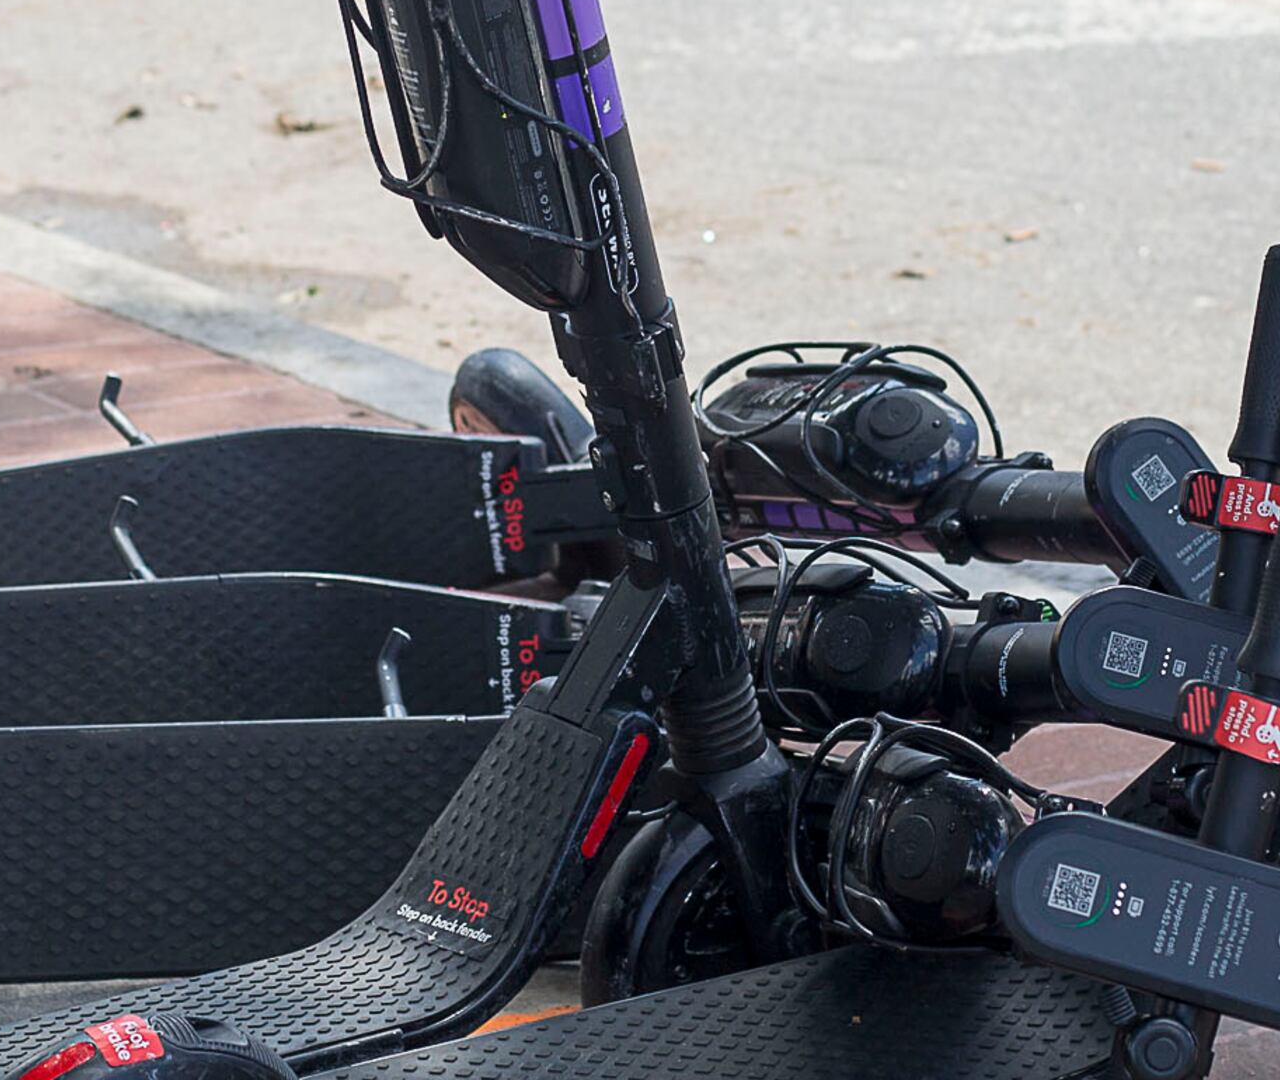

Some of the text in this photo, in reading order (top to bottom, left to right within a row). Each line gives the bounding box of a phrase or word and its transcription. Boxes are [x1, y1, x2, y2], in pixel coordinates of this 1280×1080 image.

[479, 451, 493, 481] Step
[482, 482, 492, 499] on
[1225, 491, 1235, 512] stop
[1232, 483, 1245, 522] press to
[1244, 494, 1255, 514] And
[485, 500, 501, 531] back
[498, 466, 525, 552] To Stop
[496, 614, 511, 646] Step
[500, 648, 510, 666] on
[518, 634, 539, 664] To
[501, 668, 515, 702] back
[1223, 707, 1237, 731] stop
[1233, 699, 1248, 730] press
[1240, 713, 1256, 739] And
[1228, 730, 1240, 743] to
[427, 879, 488, 923] To Stop
[1182, 882, 1193, 898] For
[397, 904, 492, 942] Step on back fender
[1172, 898, 1186, 937] support
[1188, 886, 1218, 966] lyft.com/scooters
[98, 1022, 131, 1060] brake
